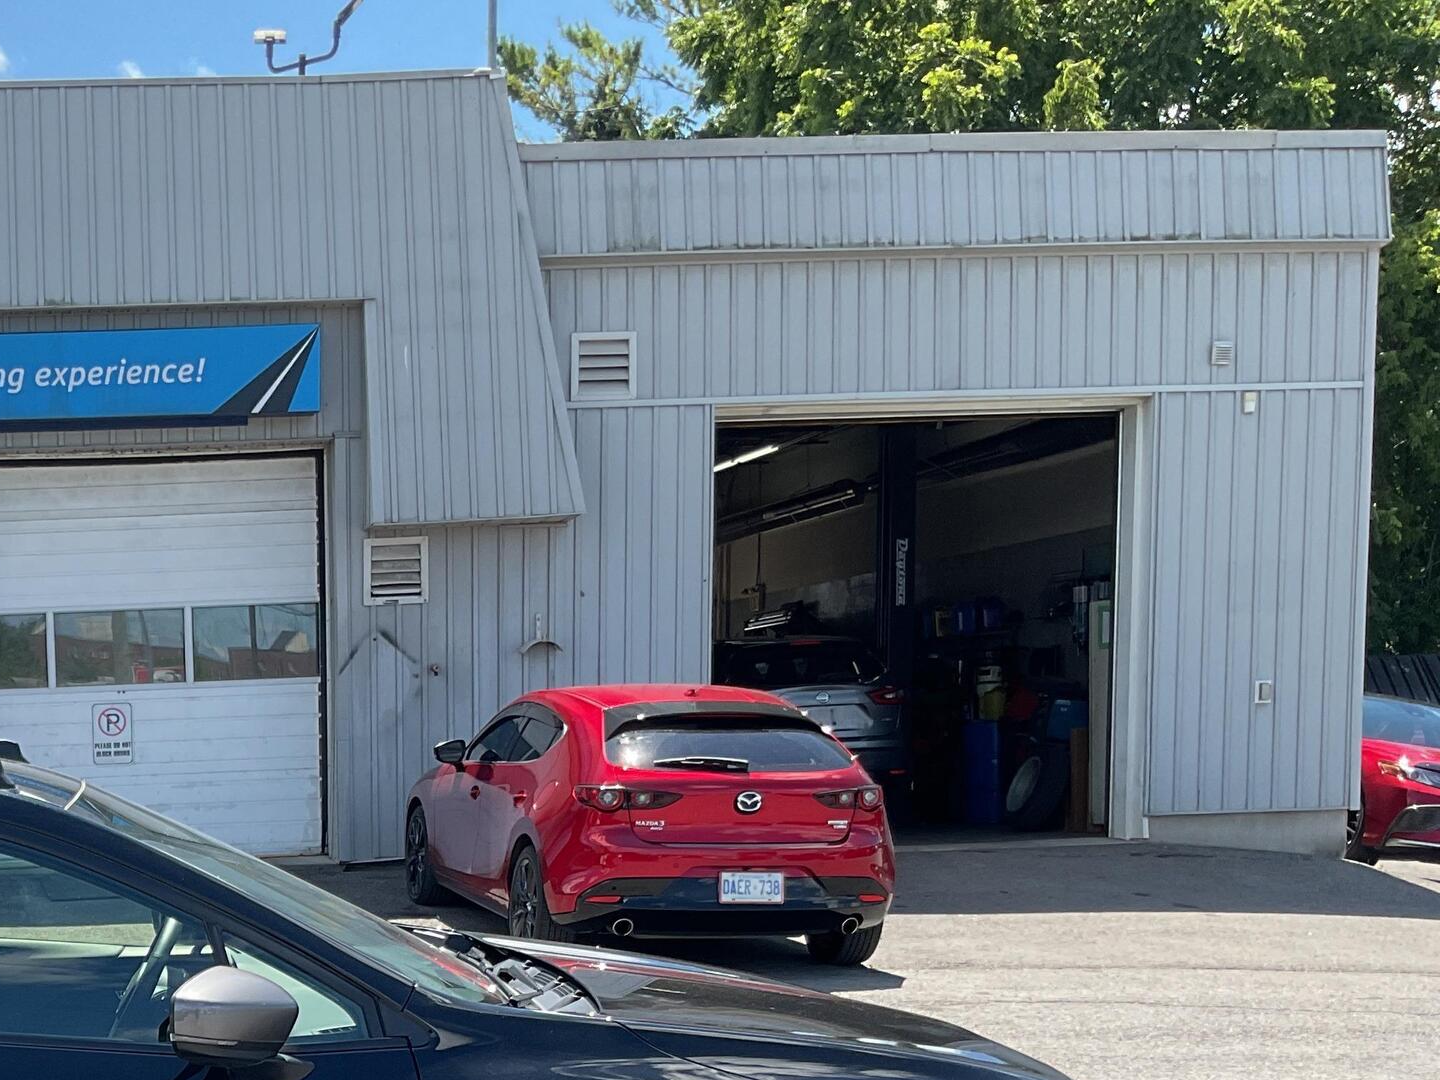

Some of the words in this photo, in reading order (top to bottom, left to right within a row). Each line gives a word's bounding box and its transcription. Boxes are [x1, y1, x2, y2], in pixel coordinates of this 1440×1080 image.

[35, 357, 206, 393] experience!
[723, 879, 752, 895] DAER
[759, 879, 780, 896] 738
